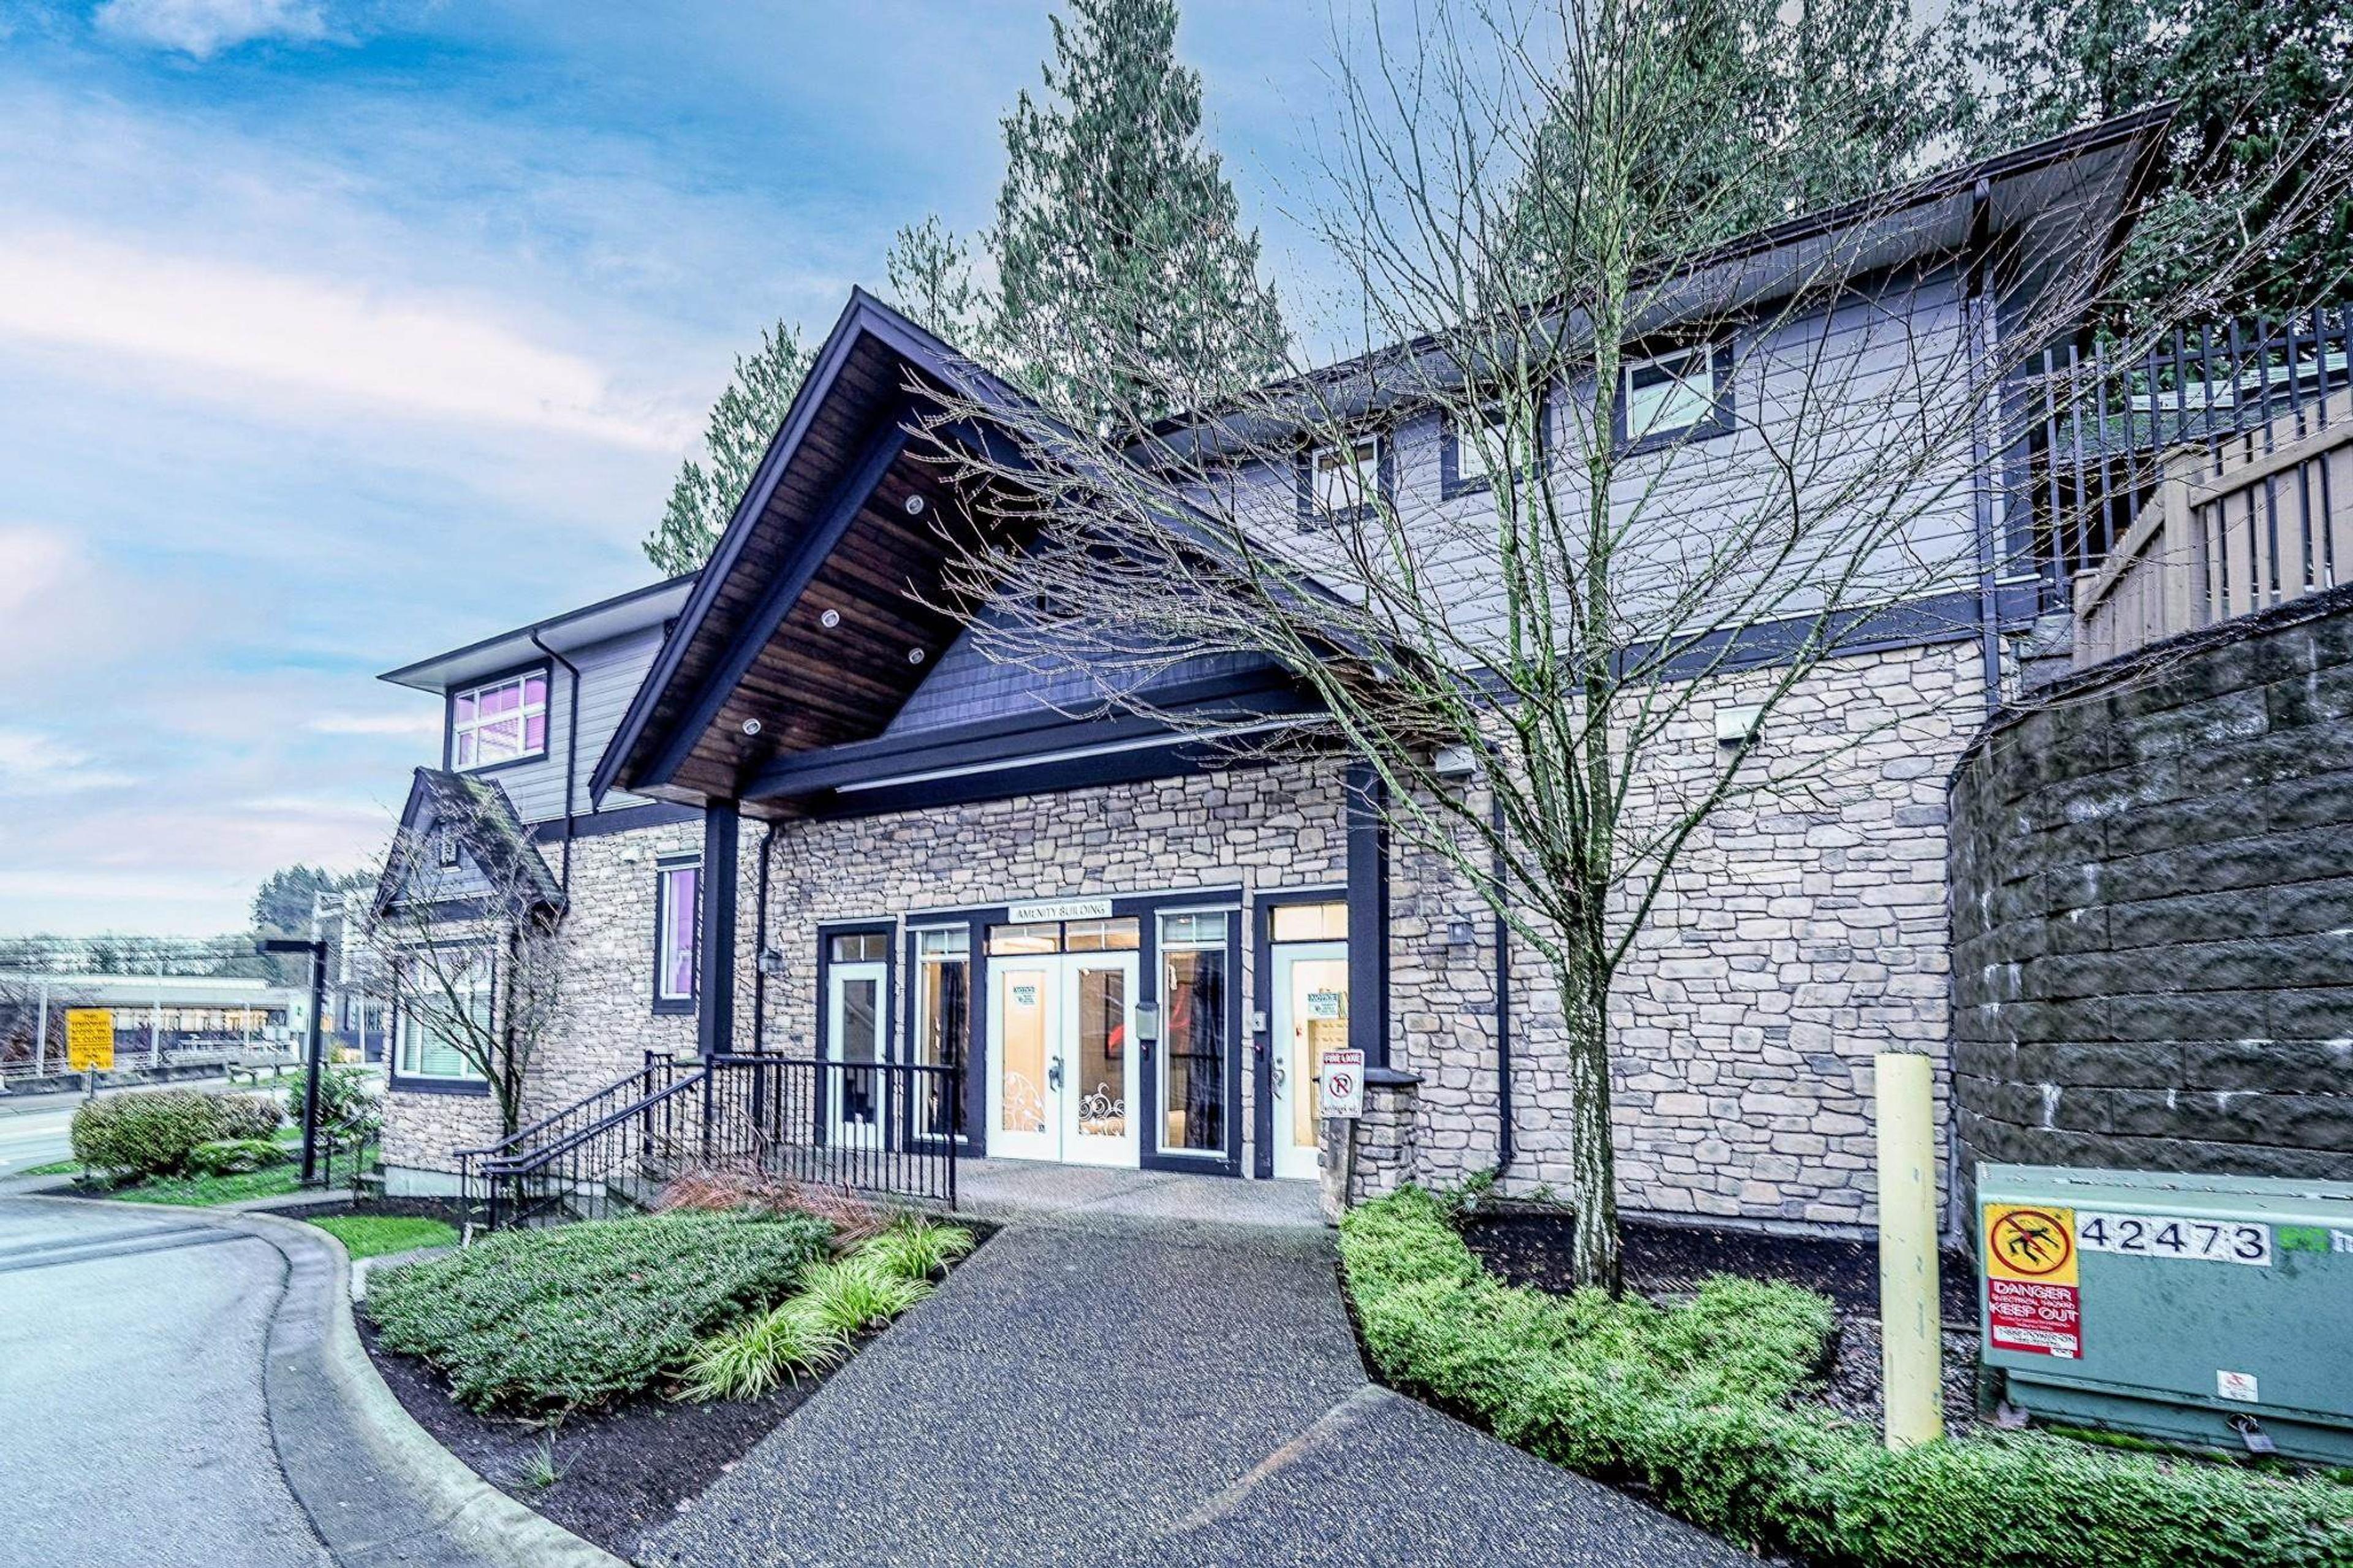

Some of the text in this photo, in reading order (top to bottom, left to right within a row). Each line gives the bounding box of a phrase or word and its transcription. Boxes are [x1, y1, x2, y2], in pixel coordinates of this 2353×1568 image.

[1018, 904, 1105, 919] AMENITY BUILDING
[2082, 1217, 2265, 1259] 42473
[1991, 1293, 2075, 1309] ELECTRICAL HAZARD
[1993, 1281, 2072, 1301] DANGER
[1989, 1301, 2036, 1317] KEEP
[2038, 1306, 2079, 1322] OUT
